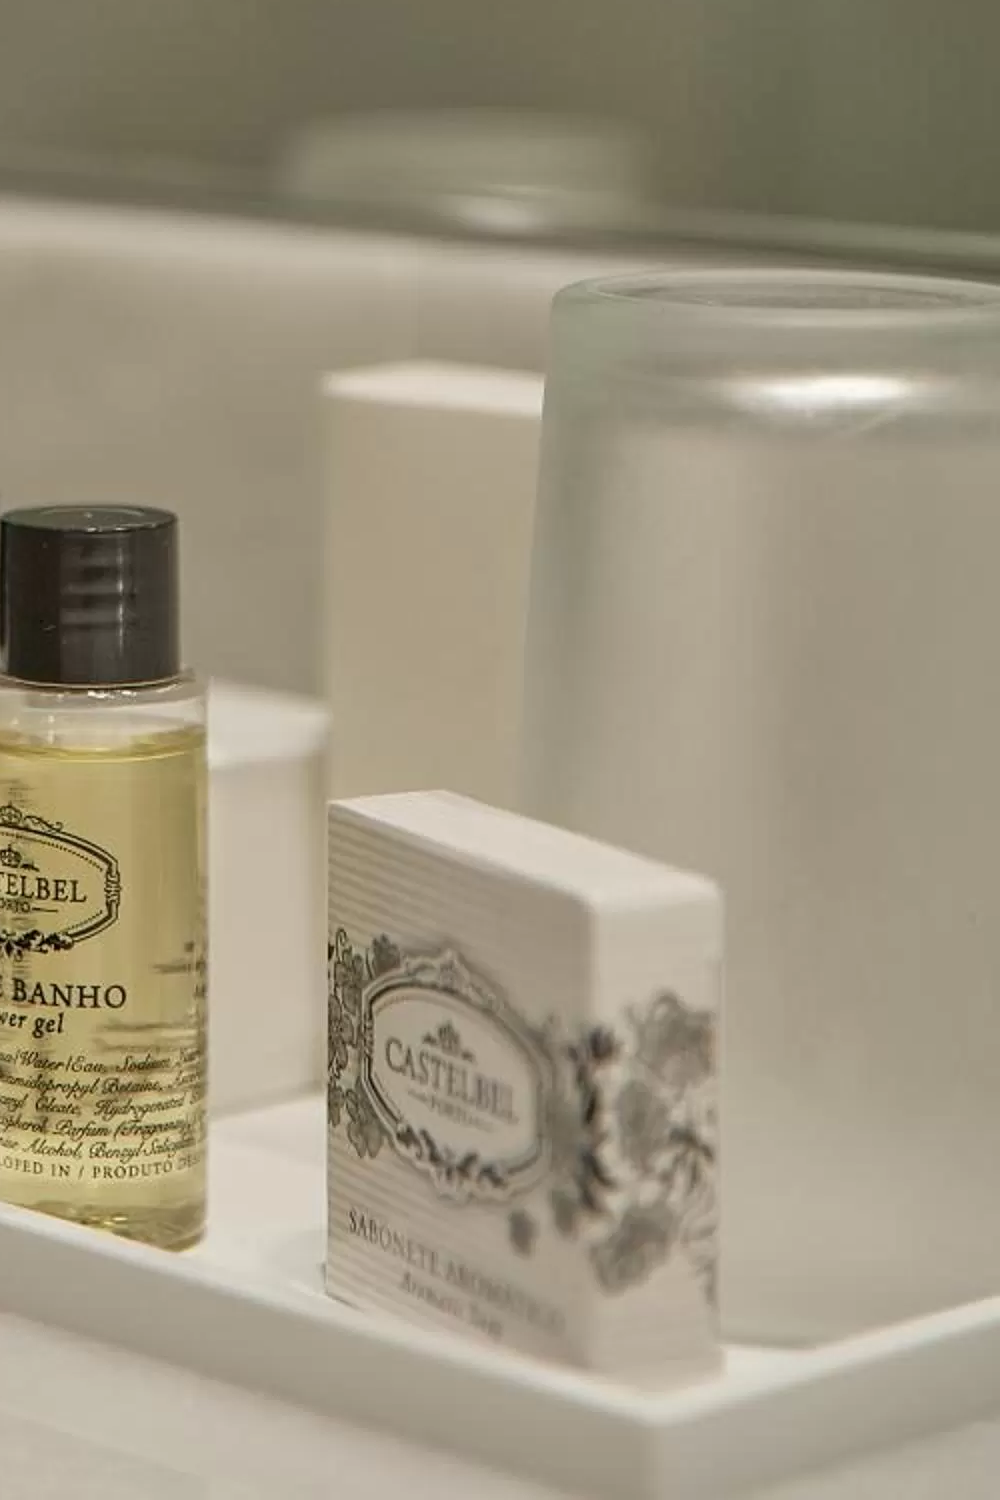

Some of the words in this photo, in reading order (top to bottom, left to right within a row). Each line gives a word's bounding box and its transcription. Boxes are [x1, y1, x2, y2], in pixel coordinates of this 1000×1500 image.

[12, 977, 127, 1009] BANHO
[32, 1012, 65, 1039] gel
[50, 1161, 71, 1178] IN
[92, 1158, 174, 1180] PRODUTO
